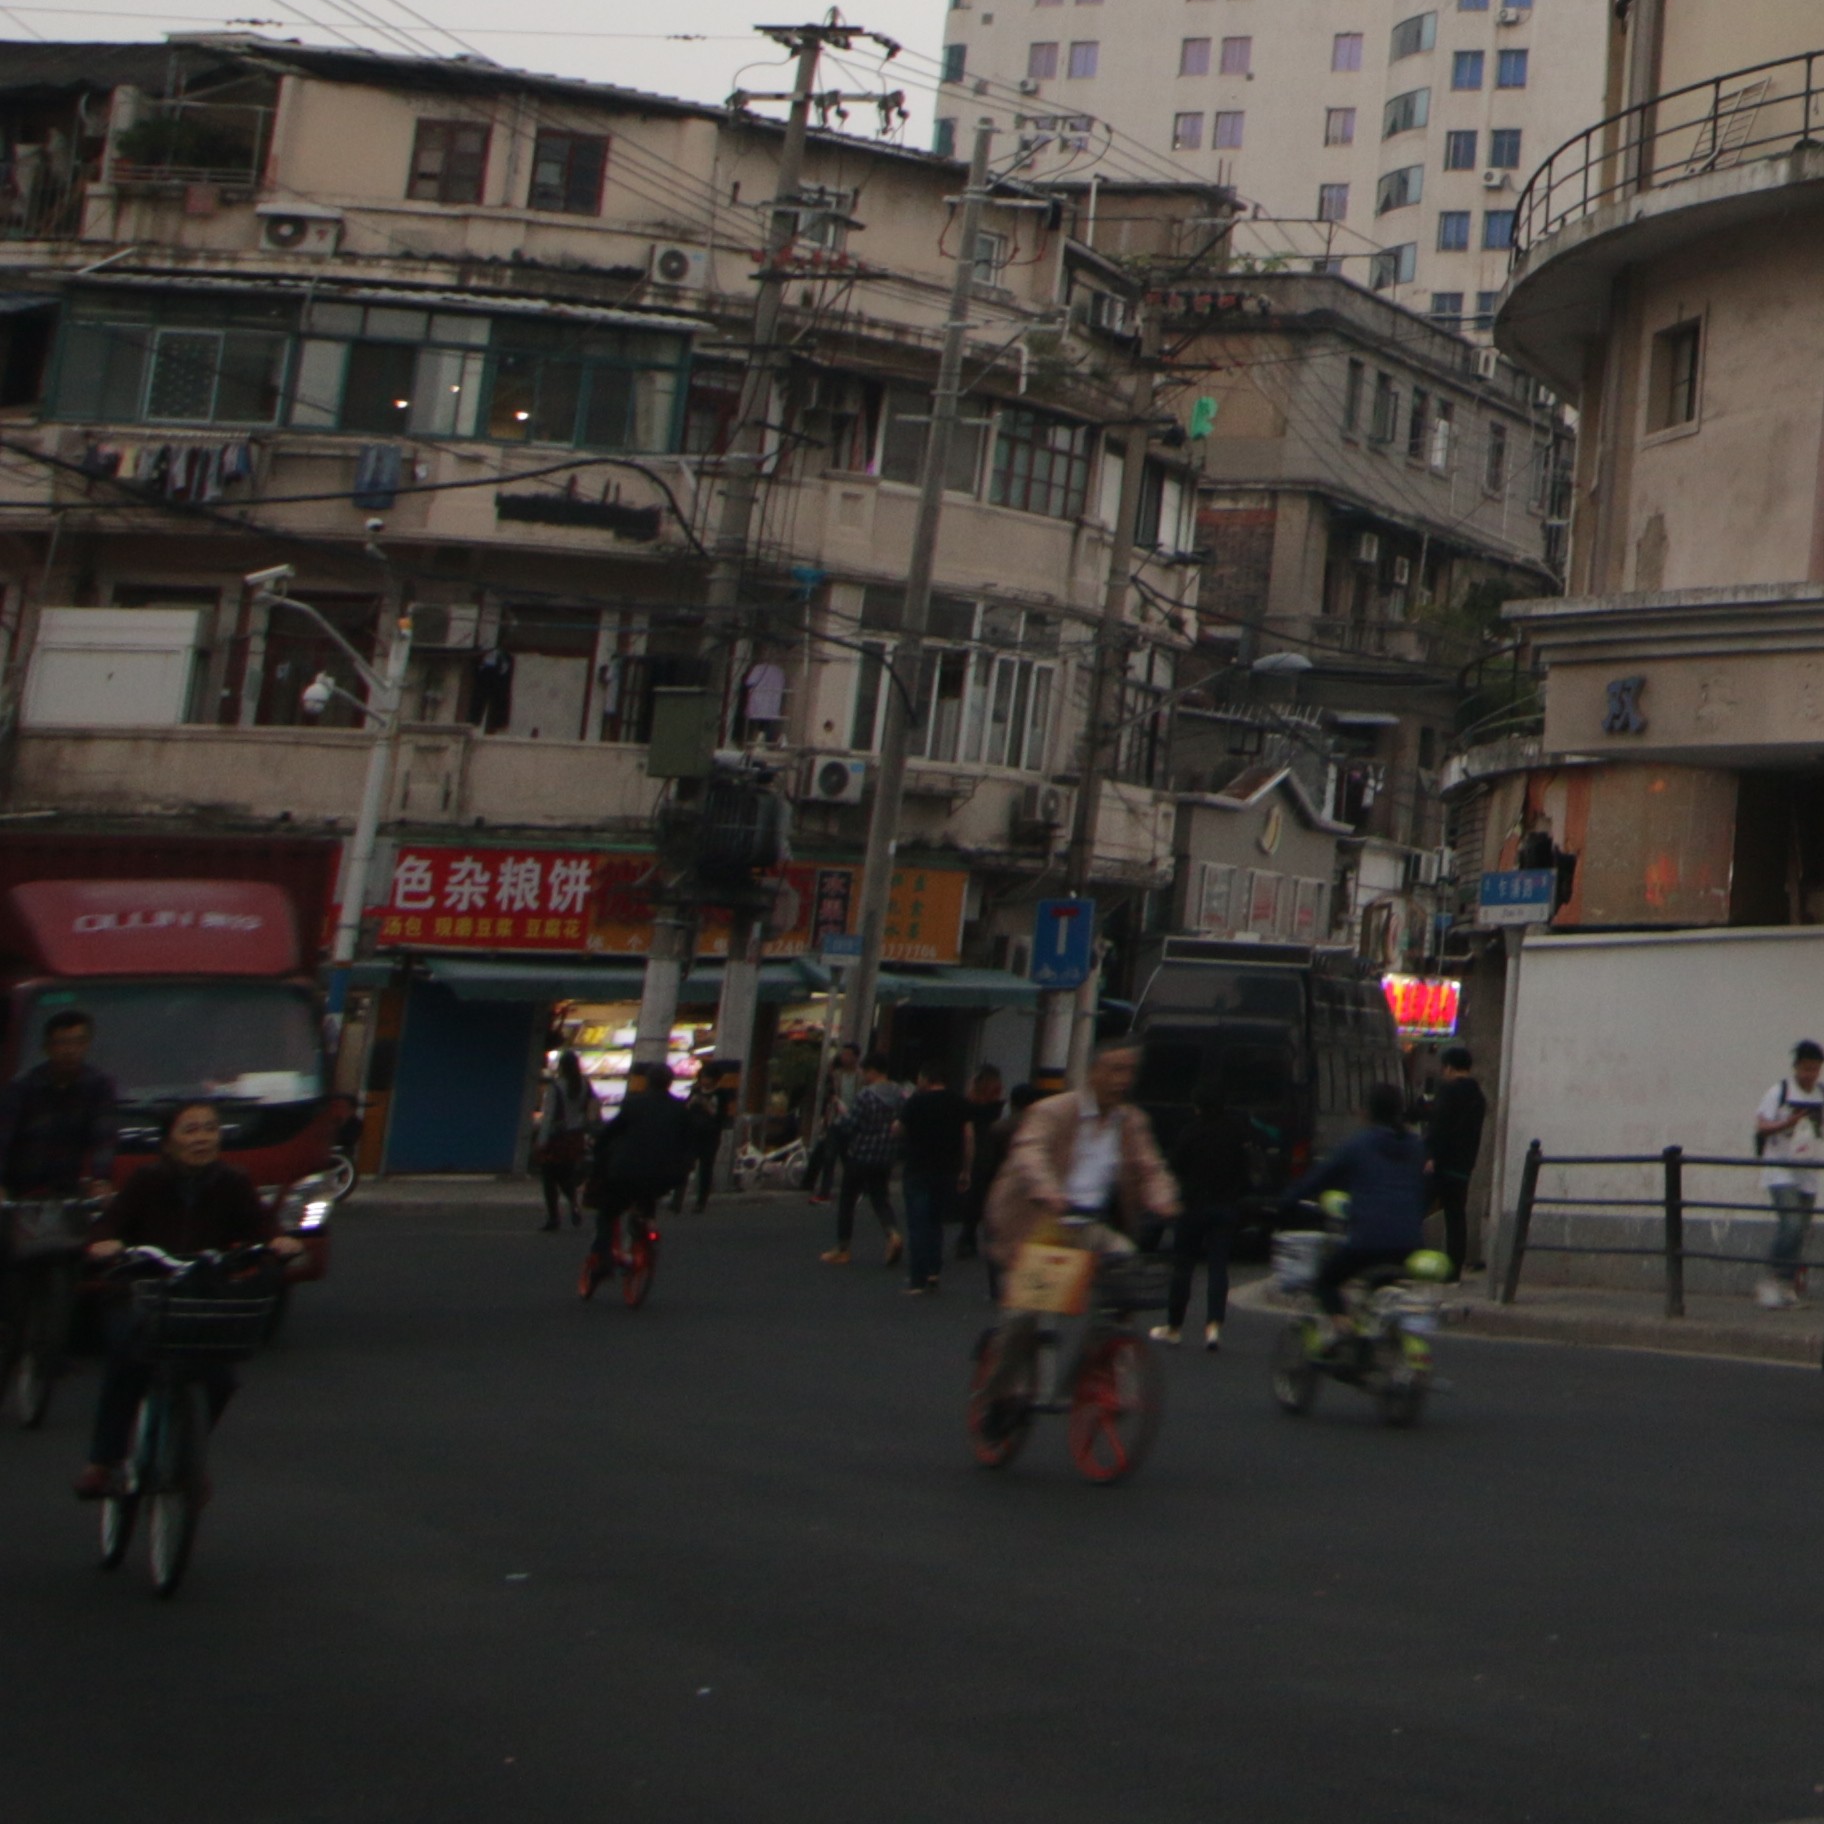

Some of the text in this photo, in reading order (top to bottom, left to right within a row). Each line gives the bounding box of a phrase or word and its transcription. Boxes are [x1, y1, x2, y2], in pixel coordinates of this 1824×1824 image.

[1602, 674, 1648, 734] 双
[392, 854, 593, 914] 色杂粮饼
